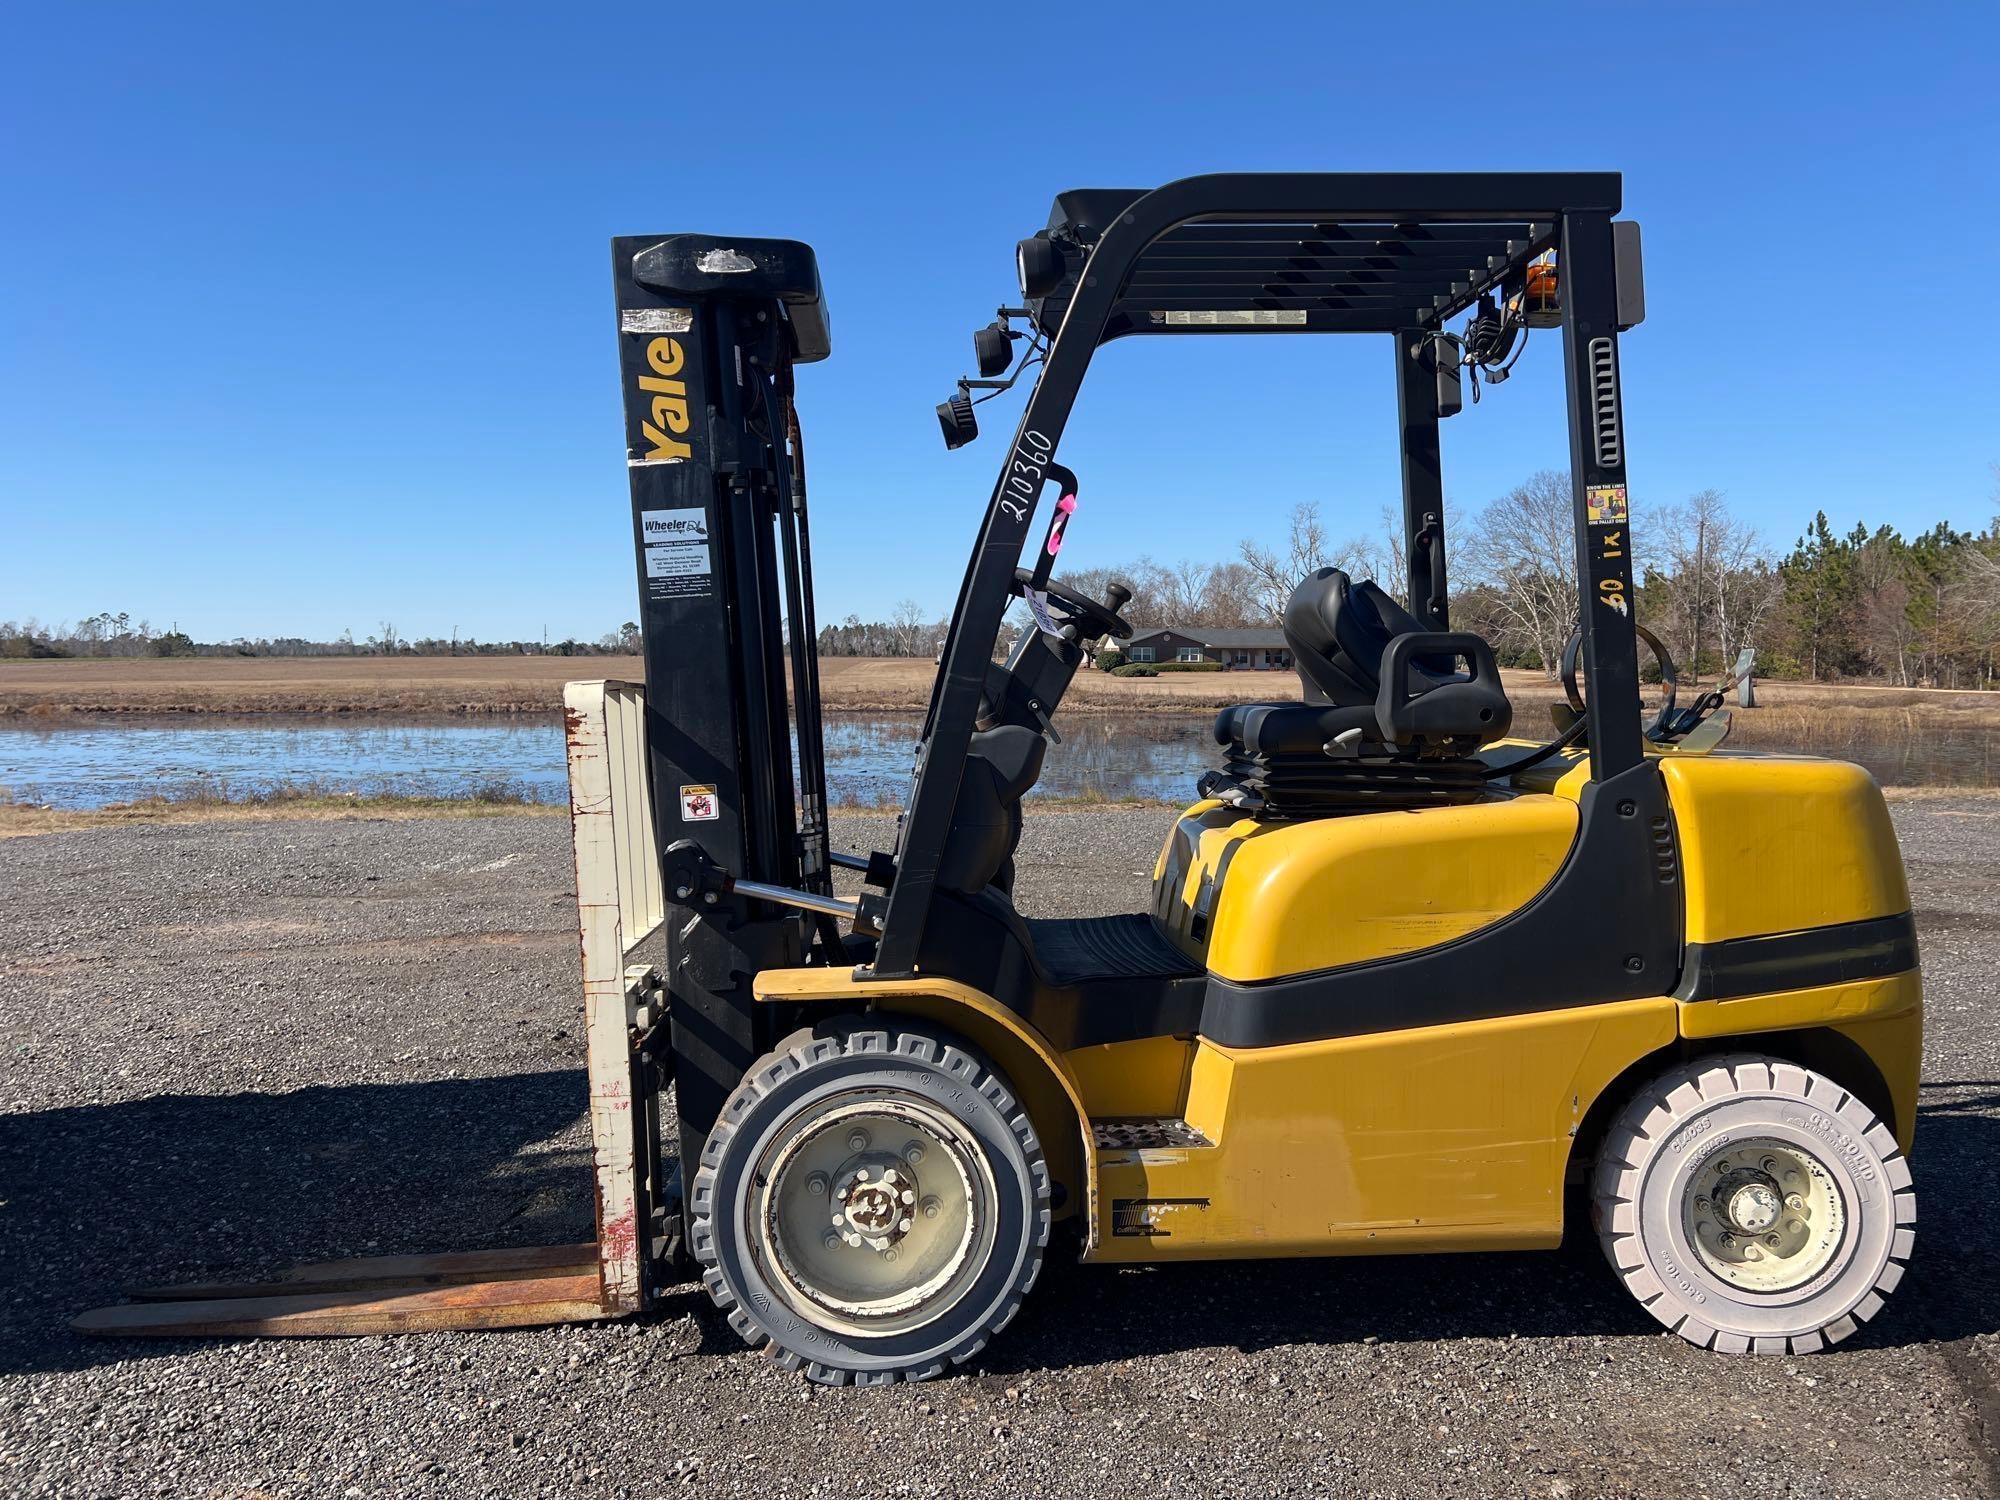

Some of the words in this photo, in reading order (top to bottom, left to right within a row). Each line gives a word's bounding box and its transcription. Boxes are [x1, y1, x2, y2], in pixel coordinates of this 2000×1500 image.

[638, 336, 691, 460] Yale
[1000, 430, 1051, 523] 210360
[645, 520, 687, 531] Wheeler
